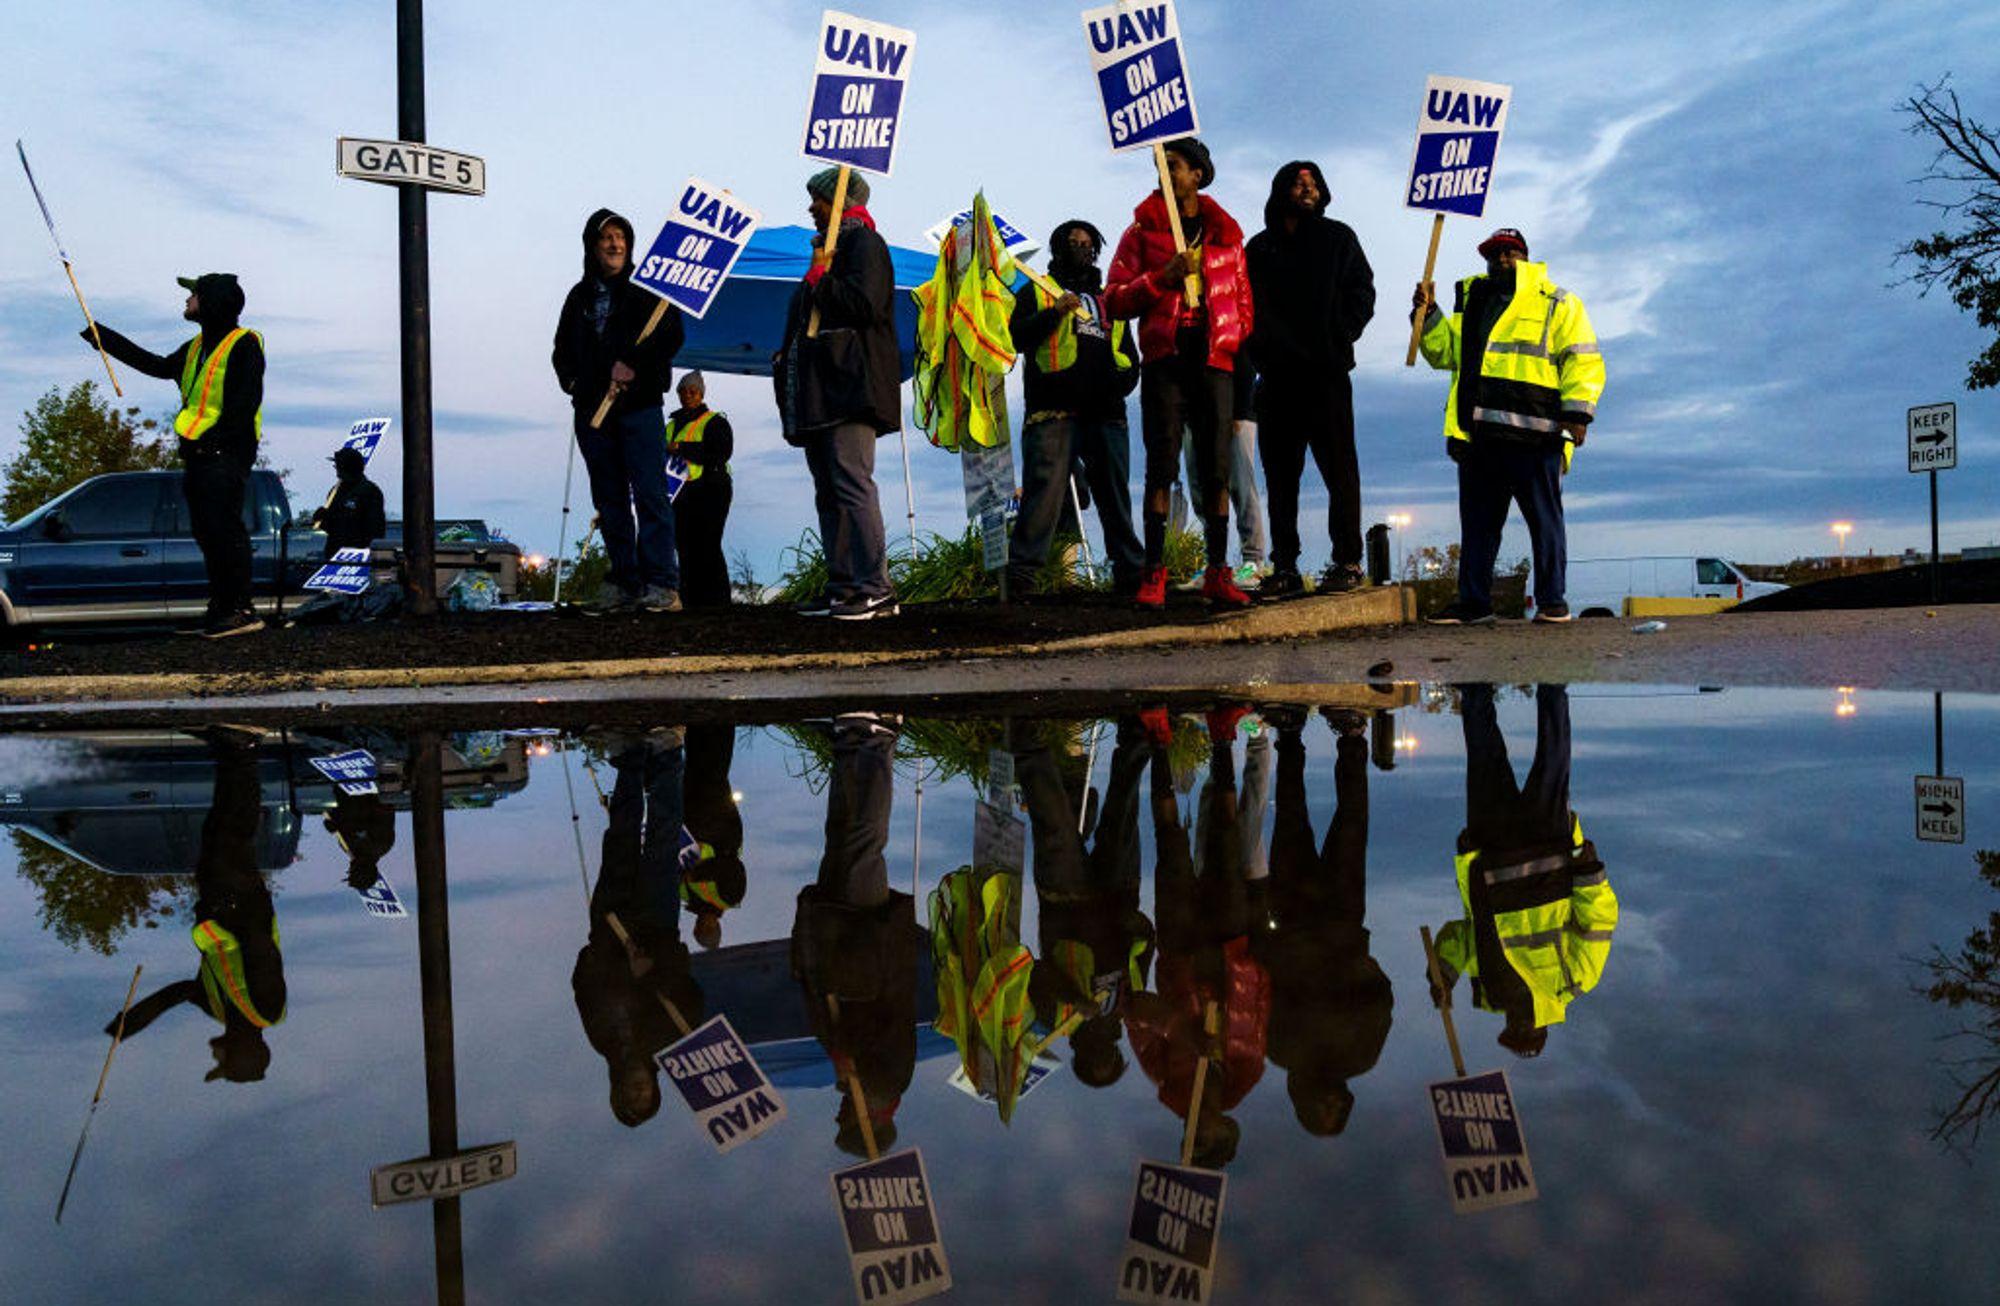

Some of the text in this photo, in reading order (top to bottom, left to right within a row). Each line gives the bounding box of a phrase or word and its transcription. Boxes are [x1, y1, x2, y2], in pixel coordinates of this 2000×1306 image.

[1088, 4, 1166, 53] UAW
[824, 25, 907, 76] UAW
[1125, 54, 1157, 96] ON
[841, 83, 875, 115] ON
[1111, 76, 1186, 141] STRIKE
[1427, 89, 1503, 128] UAW
[810, 117, 893, 151] STRIKE
[1441, 137, 1472, 168] ON
[356, 146, 472, 184] GATE 5
[1412, 166, 1488, 203] STRIKE
[680, 185, 753, 239] UAW
[676, 234, 714, 262] ON
[640, 255, 720, 292] STRIKE
[351, 421, 386, 435] UAW
[1914, 412, 1950, 428] KEEP
[1912, 447, 1953, 464] RIGHT
[310, 576, 368, 587] STRIKE
